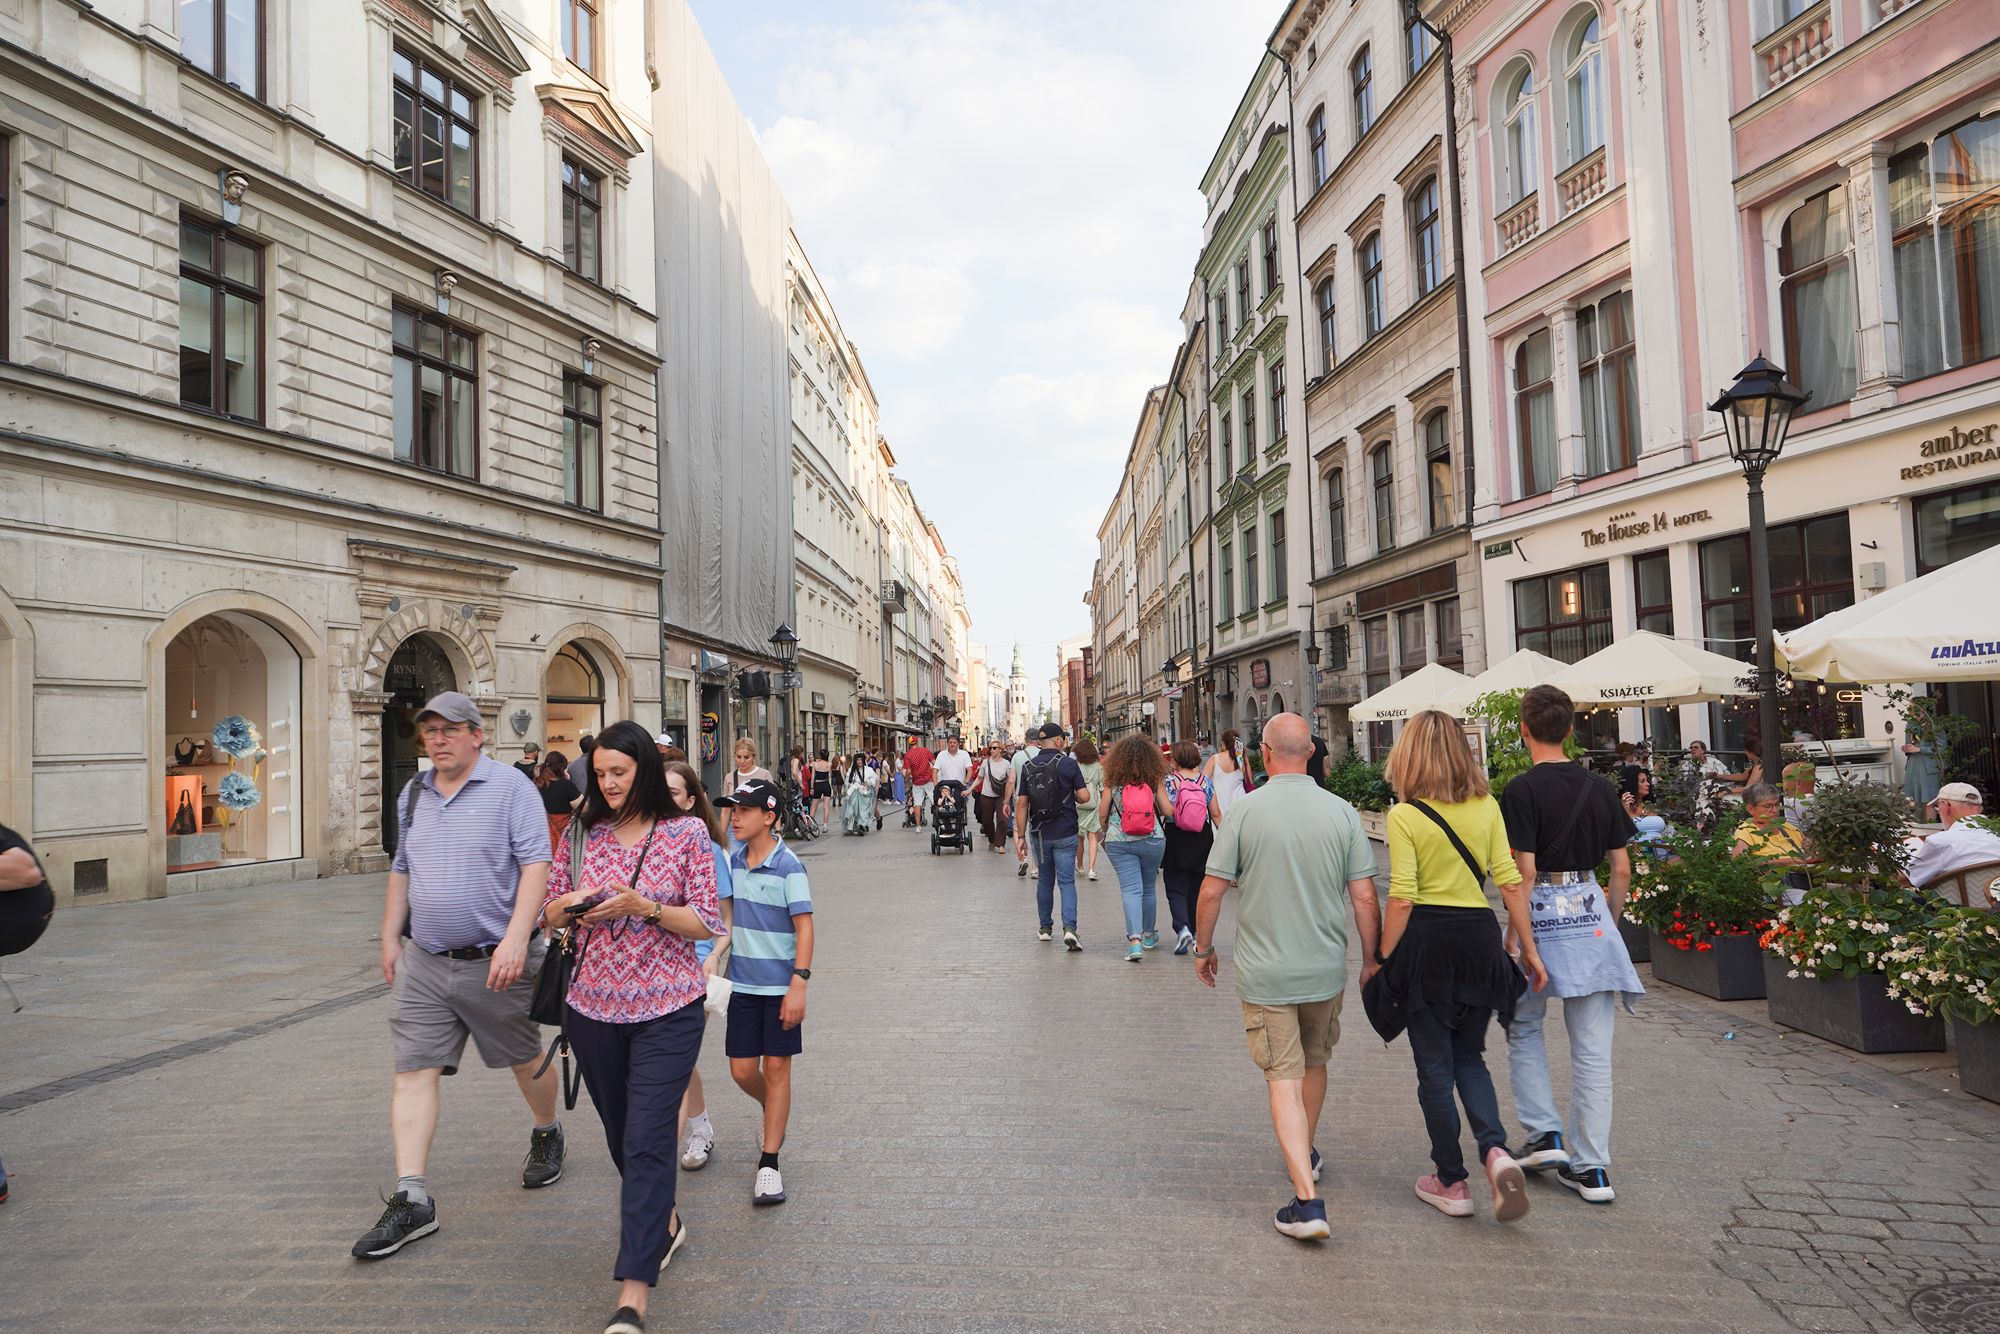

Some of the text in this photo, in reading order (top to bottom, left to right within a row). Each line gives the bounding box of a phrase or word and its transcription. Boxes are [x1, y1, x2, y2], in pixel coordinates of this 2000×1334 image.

[1920, 424, 1998, 457] amber
[1581, 510, 1713, 547] The House 14 HOTEL
[1600, 685, 1654, 699] KSIĄŻĘCE
[1533, 926, 1555, 934] STREET
